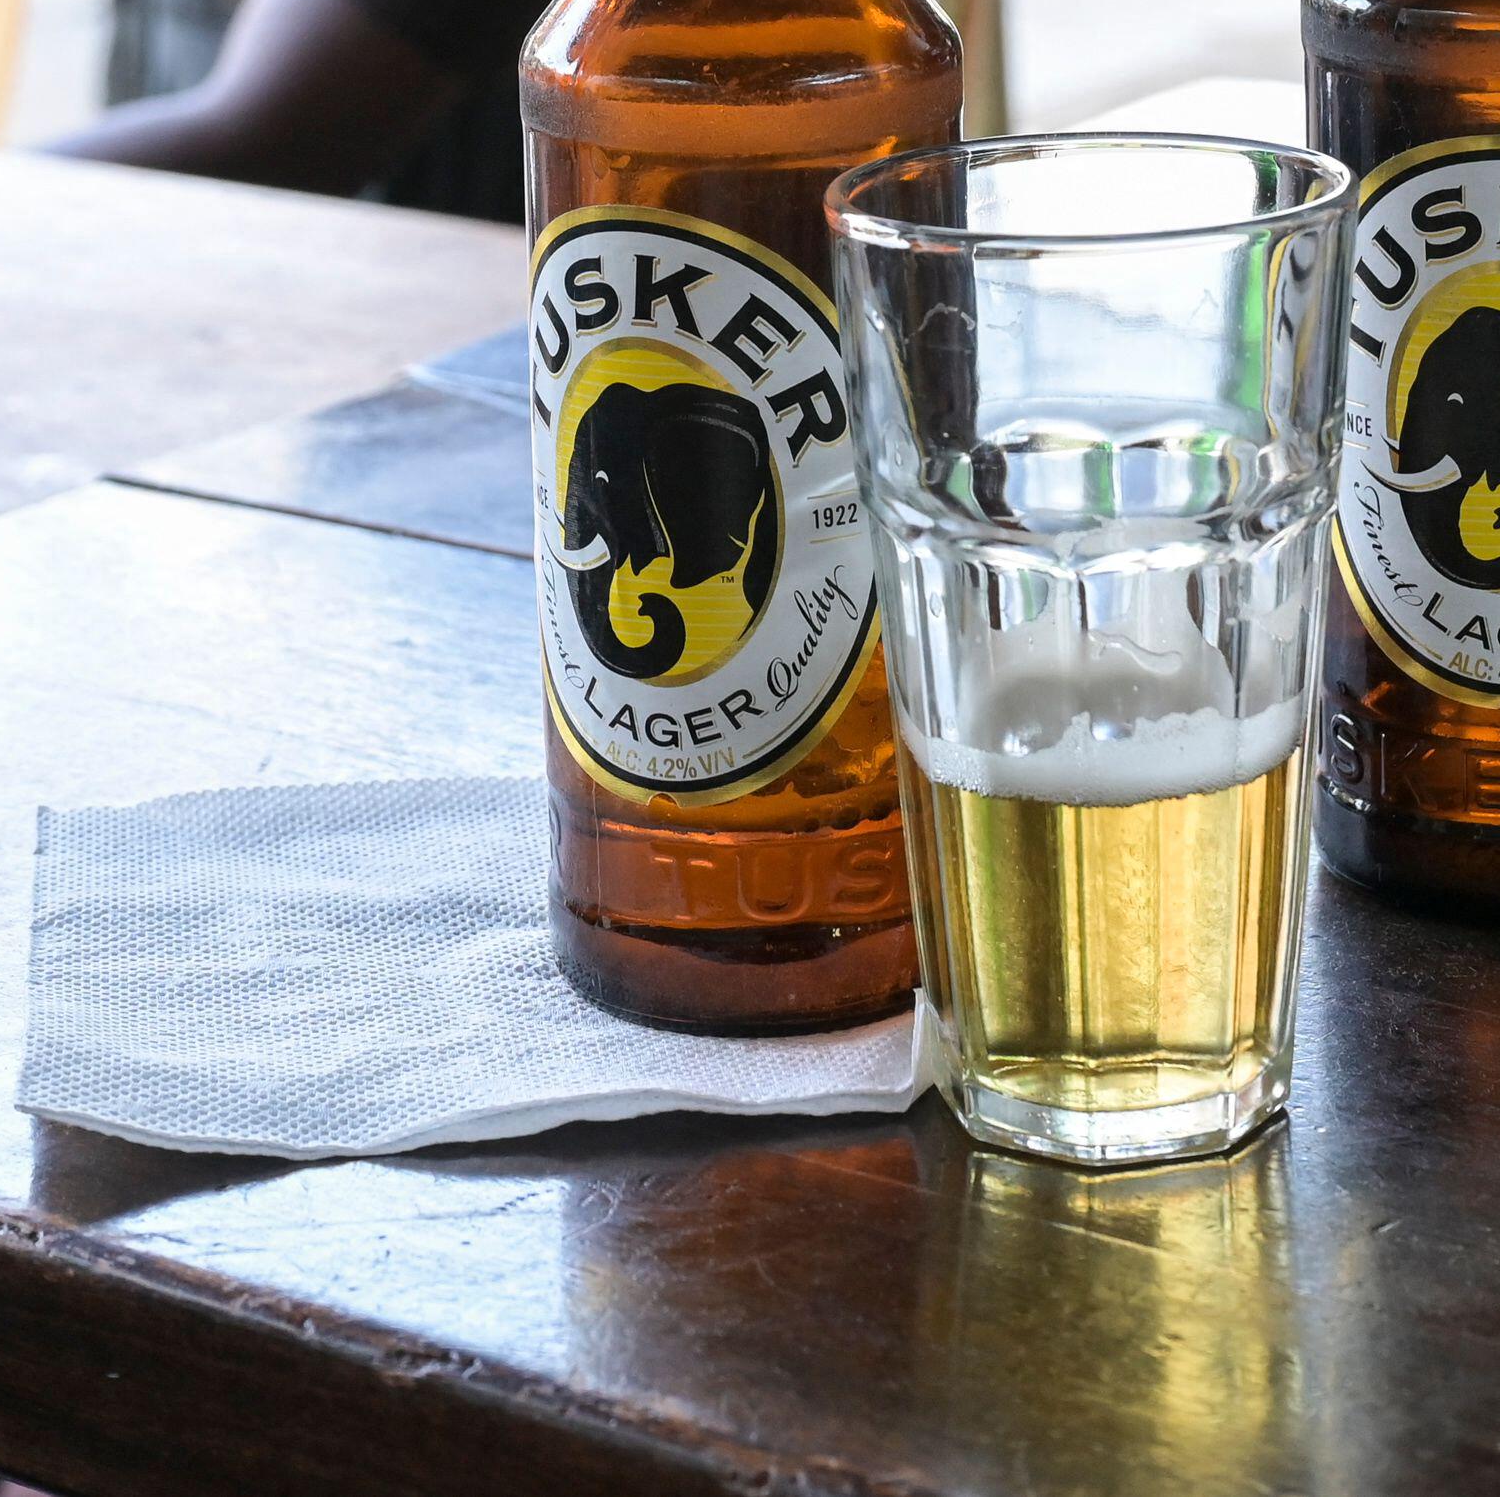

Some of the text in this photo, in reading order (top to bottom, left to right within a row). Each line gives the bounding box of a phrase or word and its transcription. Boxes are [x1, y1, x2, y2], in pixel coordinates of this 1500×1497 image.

[532, 253, 849, 469] TUSKER
[1346, 411, 1373, 438] NCE
[811, 503, 859, 530] 1922
[1353, 480, 1424, 608] Finest
[583, 675, 770, 752] LAGER
[765, 564, 860, 712] Quality
[1447, 651, 1493, 681] ALC:
[605, 740, 736, 780] ALC: 4.2% V/V
